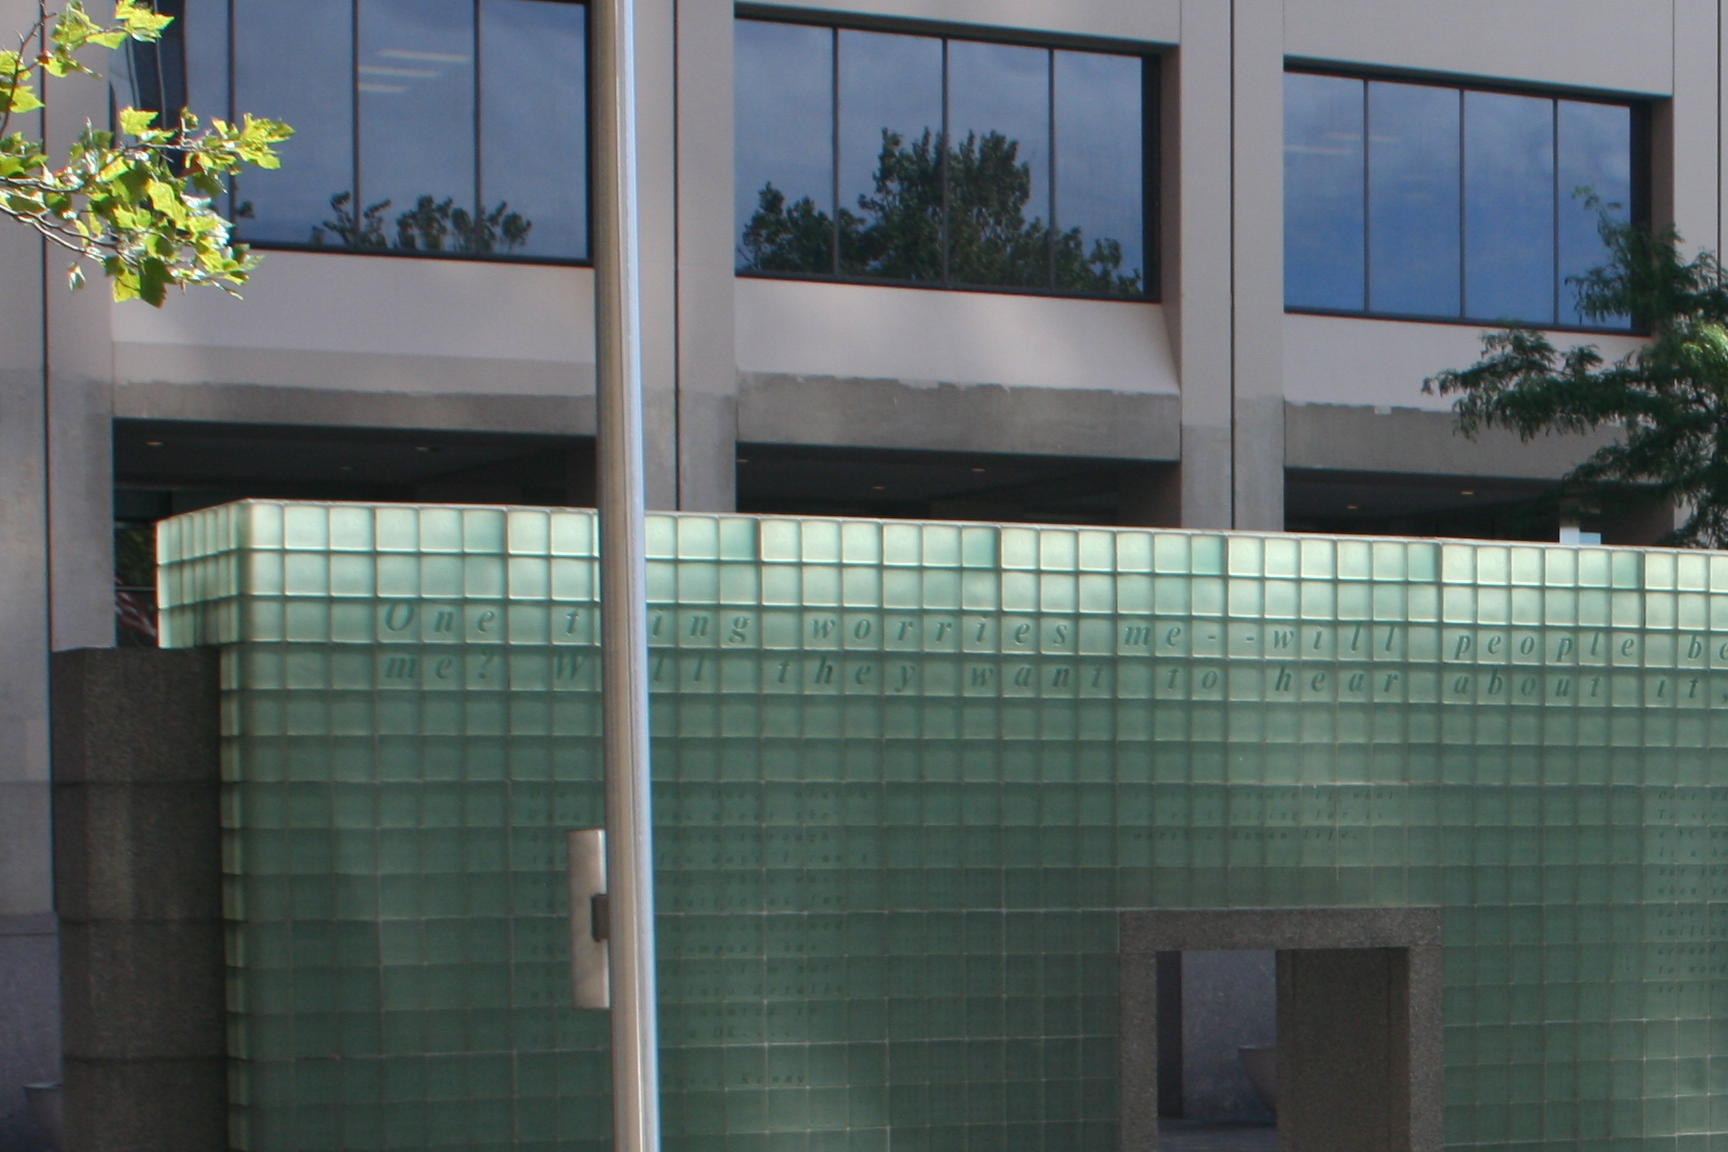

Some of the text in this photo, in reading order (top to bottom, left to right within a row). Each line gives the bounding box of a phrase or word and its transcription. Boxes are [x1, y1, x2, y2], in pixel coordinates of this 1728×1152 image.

[384, 601, 496, 635] One
[564, 605, 757, 646] ting
[811, 614, 1069, 647] worries
[1454, 629, 1636, 663] people
[383, 652, 497, 680] me?
[554, 653, 705, 683] Wll
[777, 655, 915, 692] they
[971, 664, 1103, 690] want
[1167, 666, 1219, 691] to
[1275, 665, 1399, 693] hear
[1454, 668, 1601, 698] about
